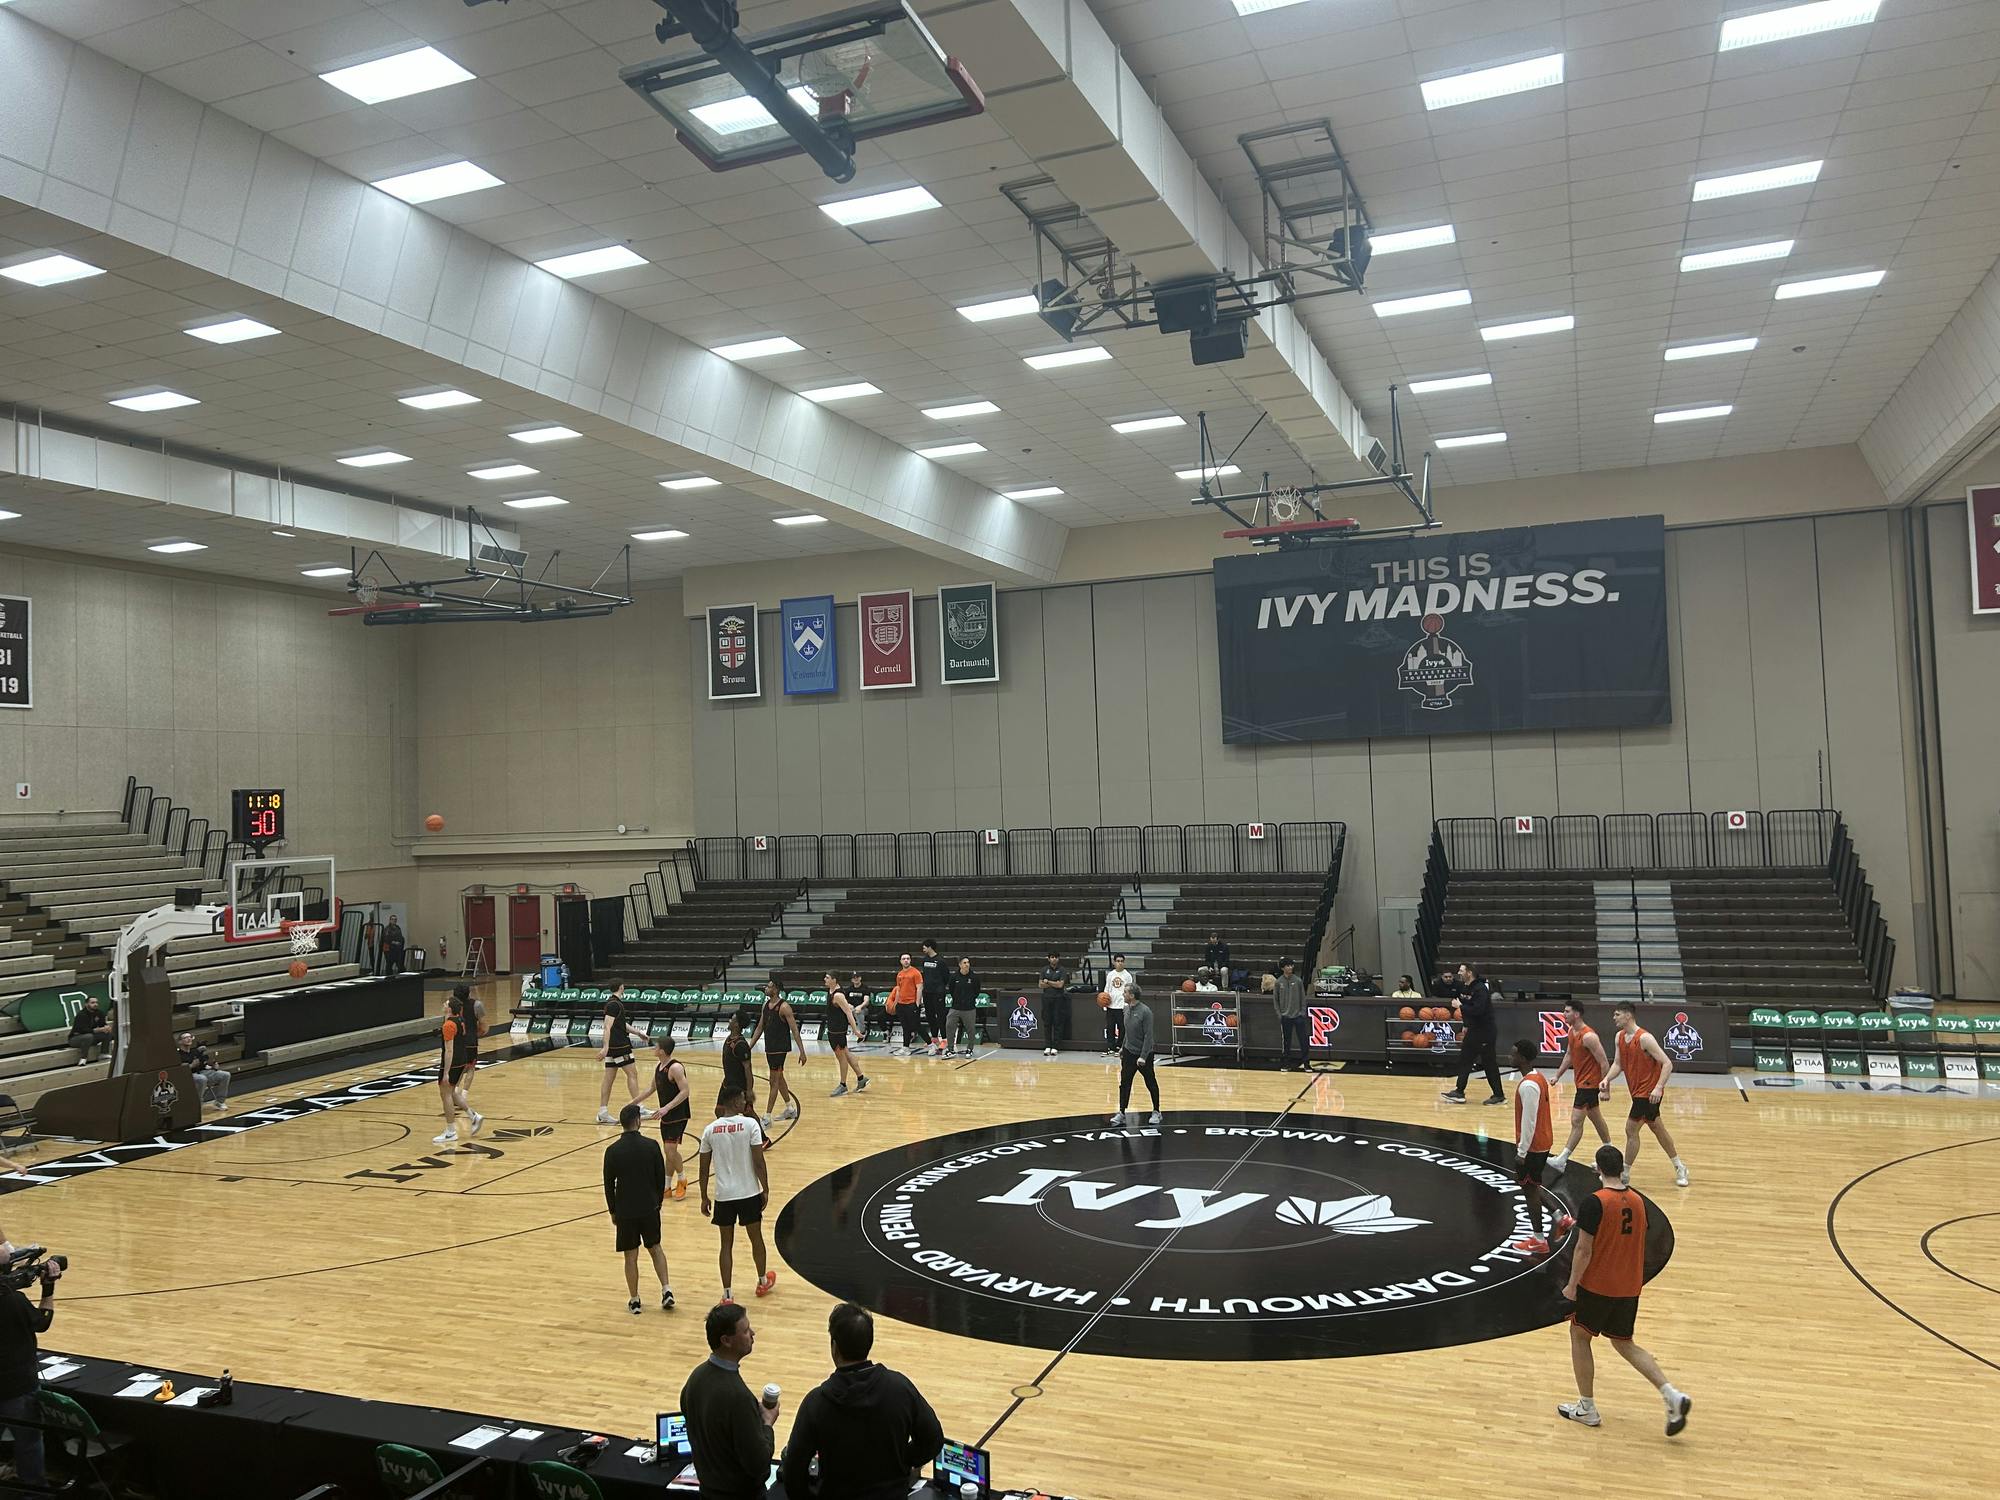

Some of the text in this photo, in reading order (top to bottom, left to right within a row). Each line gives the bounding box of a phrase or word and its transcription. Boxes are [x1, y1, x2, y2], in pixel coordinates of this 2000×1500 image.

[1370, 552, 1492, 585] THIS IS
[1257, 569, 1620, 629] IVY MADNESS.
[874, 663, 901, 674] Cornell
[949, 657, 990, 669] Dartmouth
[1425, 659, 1439, 668] Ivy
[722, 675, 746, 684] Brown
[1405, 673, 1467, 681] TOURNAMENTS
[19, 785, 29, 797] J
[248, 794, 280, 808] 11:18
[251, 810, 275, 836] 30
[1517, 818, 1531, 831] N
[1729, 813, 1745, 827] O
[987, 831, 996, 842] L
[1250, 825, 1263, 837] M
[755, 838, 766, 848] K
[1752, 1012, 1771, 1024] Ivy
[1787, 1014, 1807, 1026] Ivy
[1823, 1015, 1844, 1027] Ivy
[1861, 1016, 1880, 1028] Ivy
[1897, 1017, 1918, 1029] Ivy
[1937, 1017, 1958, 1030] Ivy
[1975, 1018, 1996, 1031] Ivy
[1307, 1006, 1340, 1047] P
[1538, 1011, 1570, 1054] P
[1758, 1055, 1775, 1066] Ivy
[1831, 1058, 1850, 1069] Ivy
[1908, 1061, 1927, 1072] Ivy
[712, 1125, 727, 1134] JUST
[1072, 1128, 1162, 1142] YALE
[1204, 1127, 1346, 1143] BROWN
[0, 1136, 198, 1185] IVY
[344, 1142, 505, 1184] Ivy
[896, 1140, 1047, 1193] PRINCETON
[1377, 1143, 1522, 1193] COLUMBIA
[977, 1168, 1270, 1229] Ivy
[879, 1203, 920, 1241] PENN
[1620, 1207, 1633, 1235] 2
[911, 1249, 1098, 1306] HARVARD
[1149, 1270, 1476, 1314] DARTMOUTH
[379, 1456, 414, 1484] Ivy
[532, 1472, 567, 1497] Ivy
